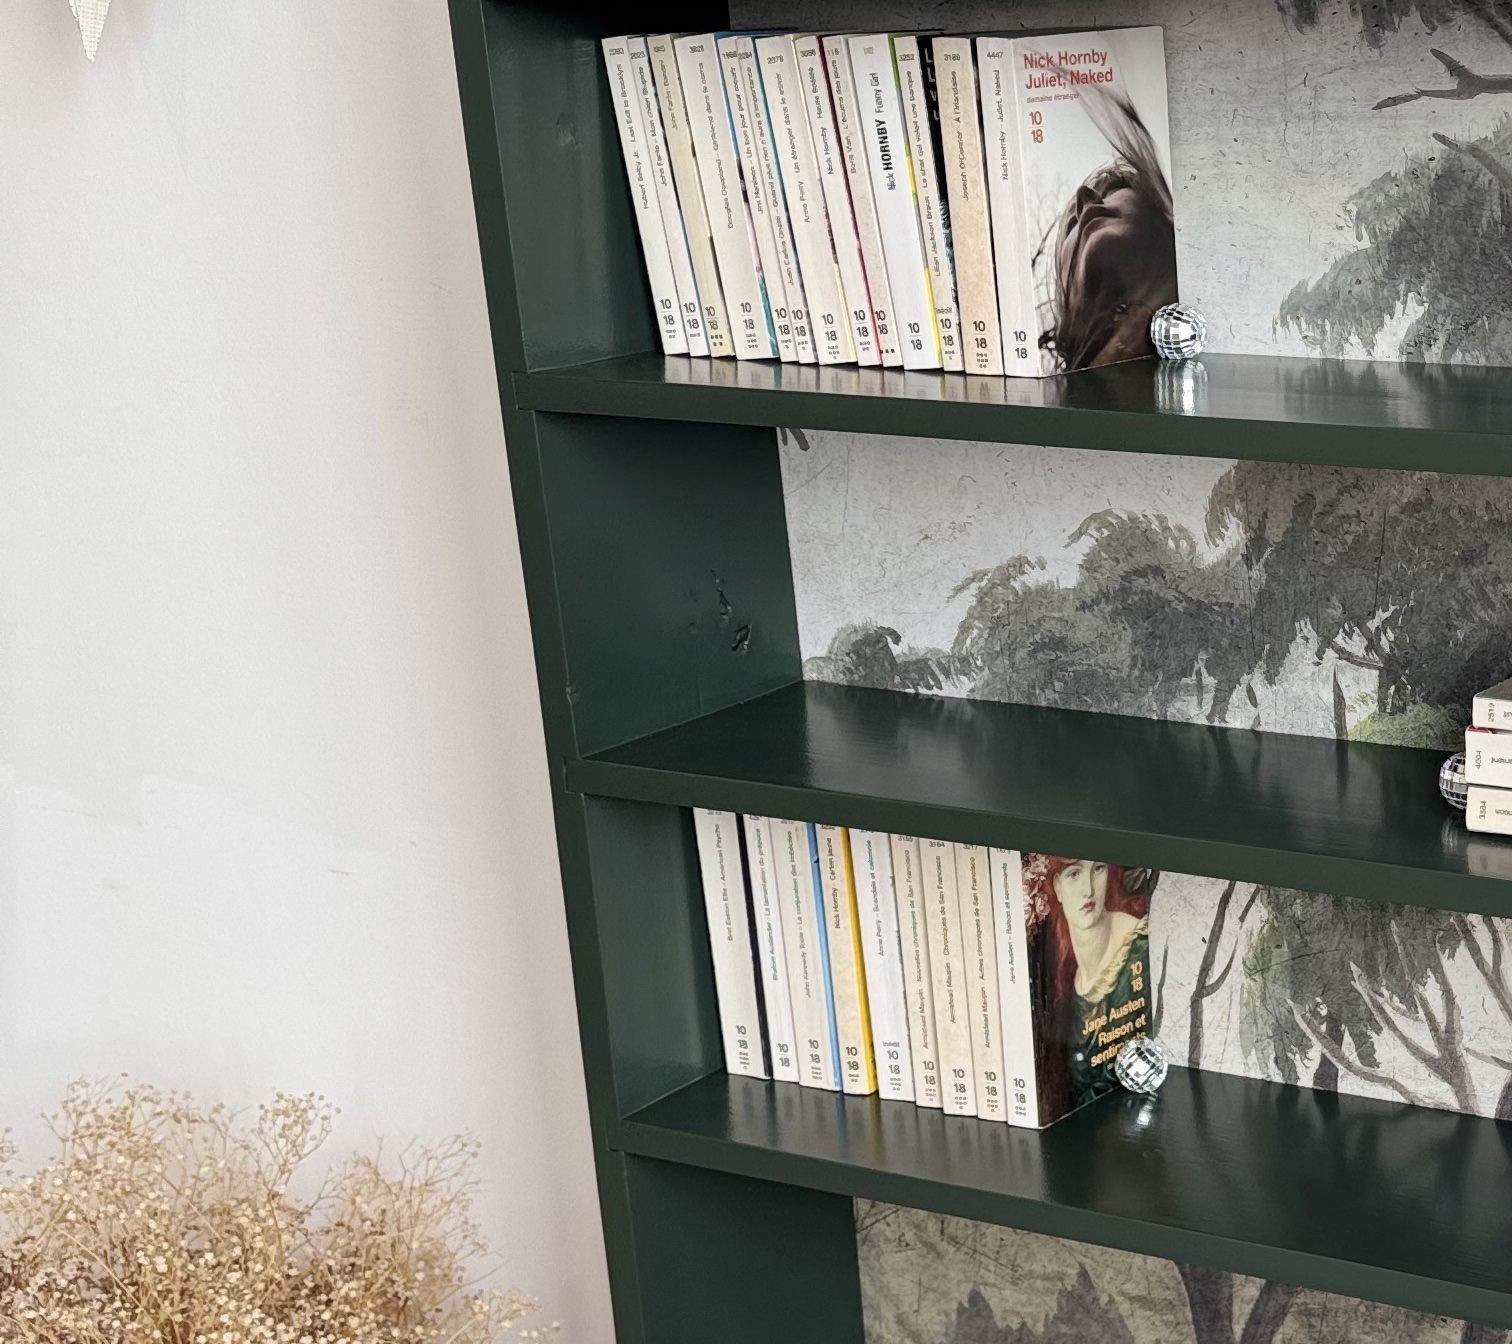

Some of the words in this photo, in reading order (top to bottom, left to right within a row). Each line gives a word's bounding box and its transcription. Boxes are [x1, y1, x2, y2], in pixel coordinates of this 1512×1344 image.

[1024, 52, 1055, 69] Nick
[1059, 49, 1107, 66] Hornby
[617, 63, 628, 98] Brooklyn
[869, 72, 880, 87] Girl
[993, 69, 1002, 96] Naked
[1025, 70, 1066, 89] Juliet,
[1070, 67, 1113, 85] Naked
[736, 93, 745, 112] pour
[874, 88, 884, 114] Funny
[740, 113, 749, 129] jour
[783, 106, 791, 126] dans
[1029, 111, 1042, 126] 10
[821, 126, 831, 156] Hornby
[1031, 129, 1043, 143] 18
[875, 119, 894, 171] HORNBY
[916, 143, 925, 157] qui
[957, 130, 966, 170] O'Connor
[999, 130, 1008, 161] Hornby
[826, 157, 835, 175] Nick
[886, 172, 897, 191] Nick
[961, 171, 969, 201] Joseph
[798, 180, 807, 202] Perry
[803, 203, 811, 223] Anne
[929, 221, 938, 255] Jackson
[660, 298, 672, 309] 10
[683, 302, 696, 313] 10
[740, 302, 751, 313] 10
[705, 306, 716, 317] 10
[775, 308, 787, 319] 10
[791, 309, 803, 320] 10
[853, 310, 866, 321] 10
[875, 310, 886, 321] 10
[663, 315, 675, 325] 18
[687, 319, 699, 329] 18
[744, 319, 755, 329] 18
[822, 314, 834, 325] 10
[940, 318, 952, 329] 10
[778, 325, 790, 335] 18
[795, 326, 807, 337] 18
[857, 326, 869, 337] 18
[908, 322, 920, 334] 10
[973, 320, 986, 332] 10
[825, 330, 837, 341] 18
[943, 335, 954, 346] 18
[1013, 331, 1026, 342] 10
[911, 339, 923, 350] 18
[975, 338, 987, 349] 18
[1015, 348, 1028, 359] 18
[935, 855, 944, 890] Francisco
[831, 886, 840, 913] Hornby
[833, 913, 841, 929] Nick
[1130, 961, 1143, 976] 10
[1131, 976, 1143, 992] 18
[1082, 1015, 1107, 1035] Jane
[1109, 997, 1146, 1022] Austen
[736, 1025, 746, 1034] 10
[1098, 1021, 1134, 1047] Raison
[1135, 1014, 1147, 1028] et
[778, 1044, 788, 1053] 10
[808, 1039, 819, 1049] 10
[846, 1046, 857, 1056] 10
[887, 1050, 898, 1060] 10
[779, 1058, 790, 1067] 18
[847, 1061, 859, 1070] 18
[922, 1061, 934, 1070] 10
[889, 1064, 900, 1074] 18
[952, 1069, 965, 1078] 10
[924, 1075, 936, 1085] 18
[984, 1071, 996, 1081] 10
[954, 1083, 966, 1093] 18
[1013, 1078, 1025, 1088] 10
[985, 1086, 997, 1096] 18
[1015, 1093, 1026, 1103] 18
